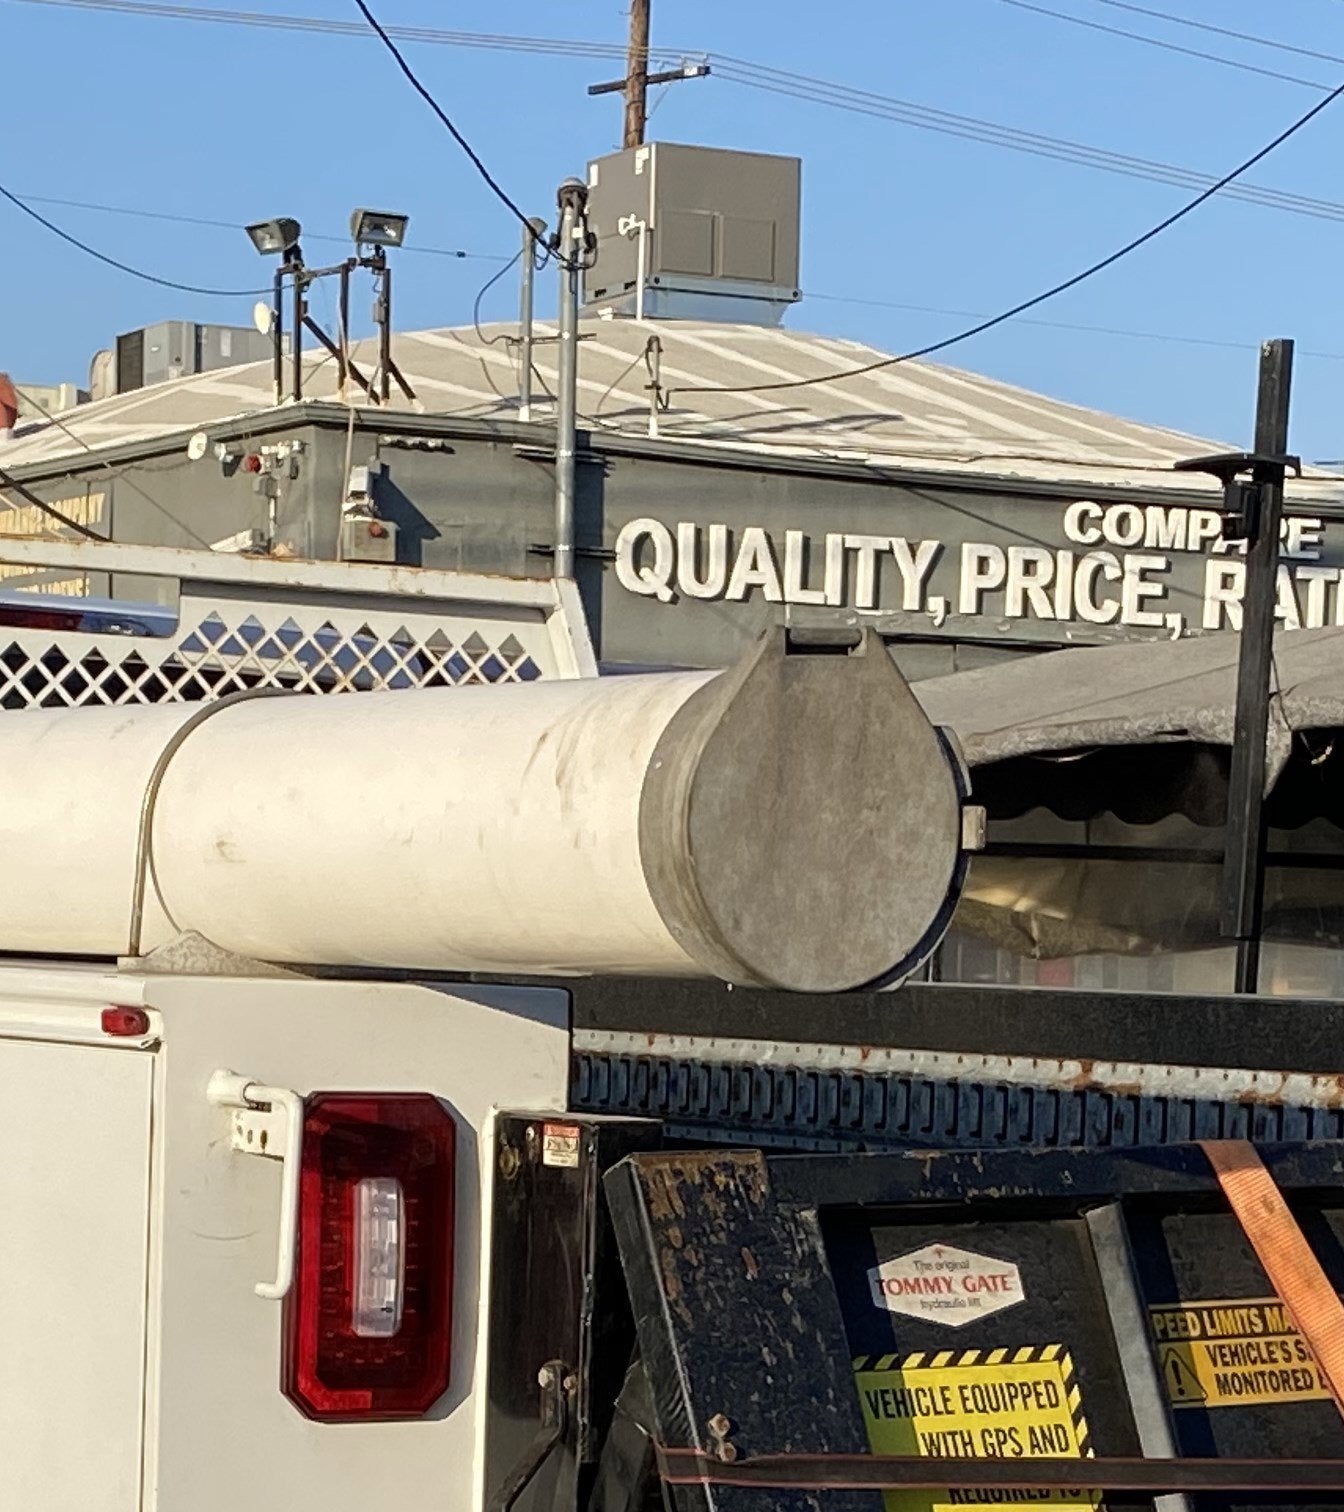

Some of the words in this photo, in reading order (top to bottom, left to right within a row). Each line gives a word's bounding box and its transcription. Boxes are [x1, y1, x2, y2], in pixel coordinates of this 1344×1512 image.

[1064, 501, 1321, 560] COMPE
[615, 518, 945, 626] QUALITY,
[959, 542, 1182, 640] PRICE,
[914, 1260, 933, 1274] The
[935, 1260, 969, 1271] original
[876, 1276, 953, 1296] TOMMY
[962, 1274, 1012, 1293] GATE
[1152, 1309, 1201, 1339] PEED
[1204, 1305, 1264, 1337] LIMITS
[1205, 1340, 1293, 1367] VEHICLE'S
[865, 1384, 954, 1420] VEHICLE
[961, 1379, 1060, 1416] EQUIPPED
[1215, 1369, 1313, 1396] MONITORED
[920, 1429, 975, 1457] WITH
[982, 1428, 1023, 1457] GPS
[1029, 1423, 1070, 1453] AND
